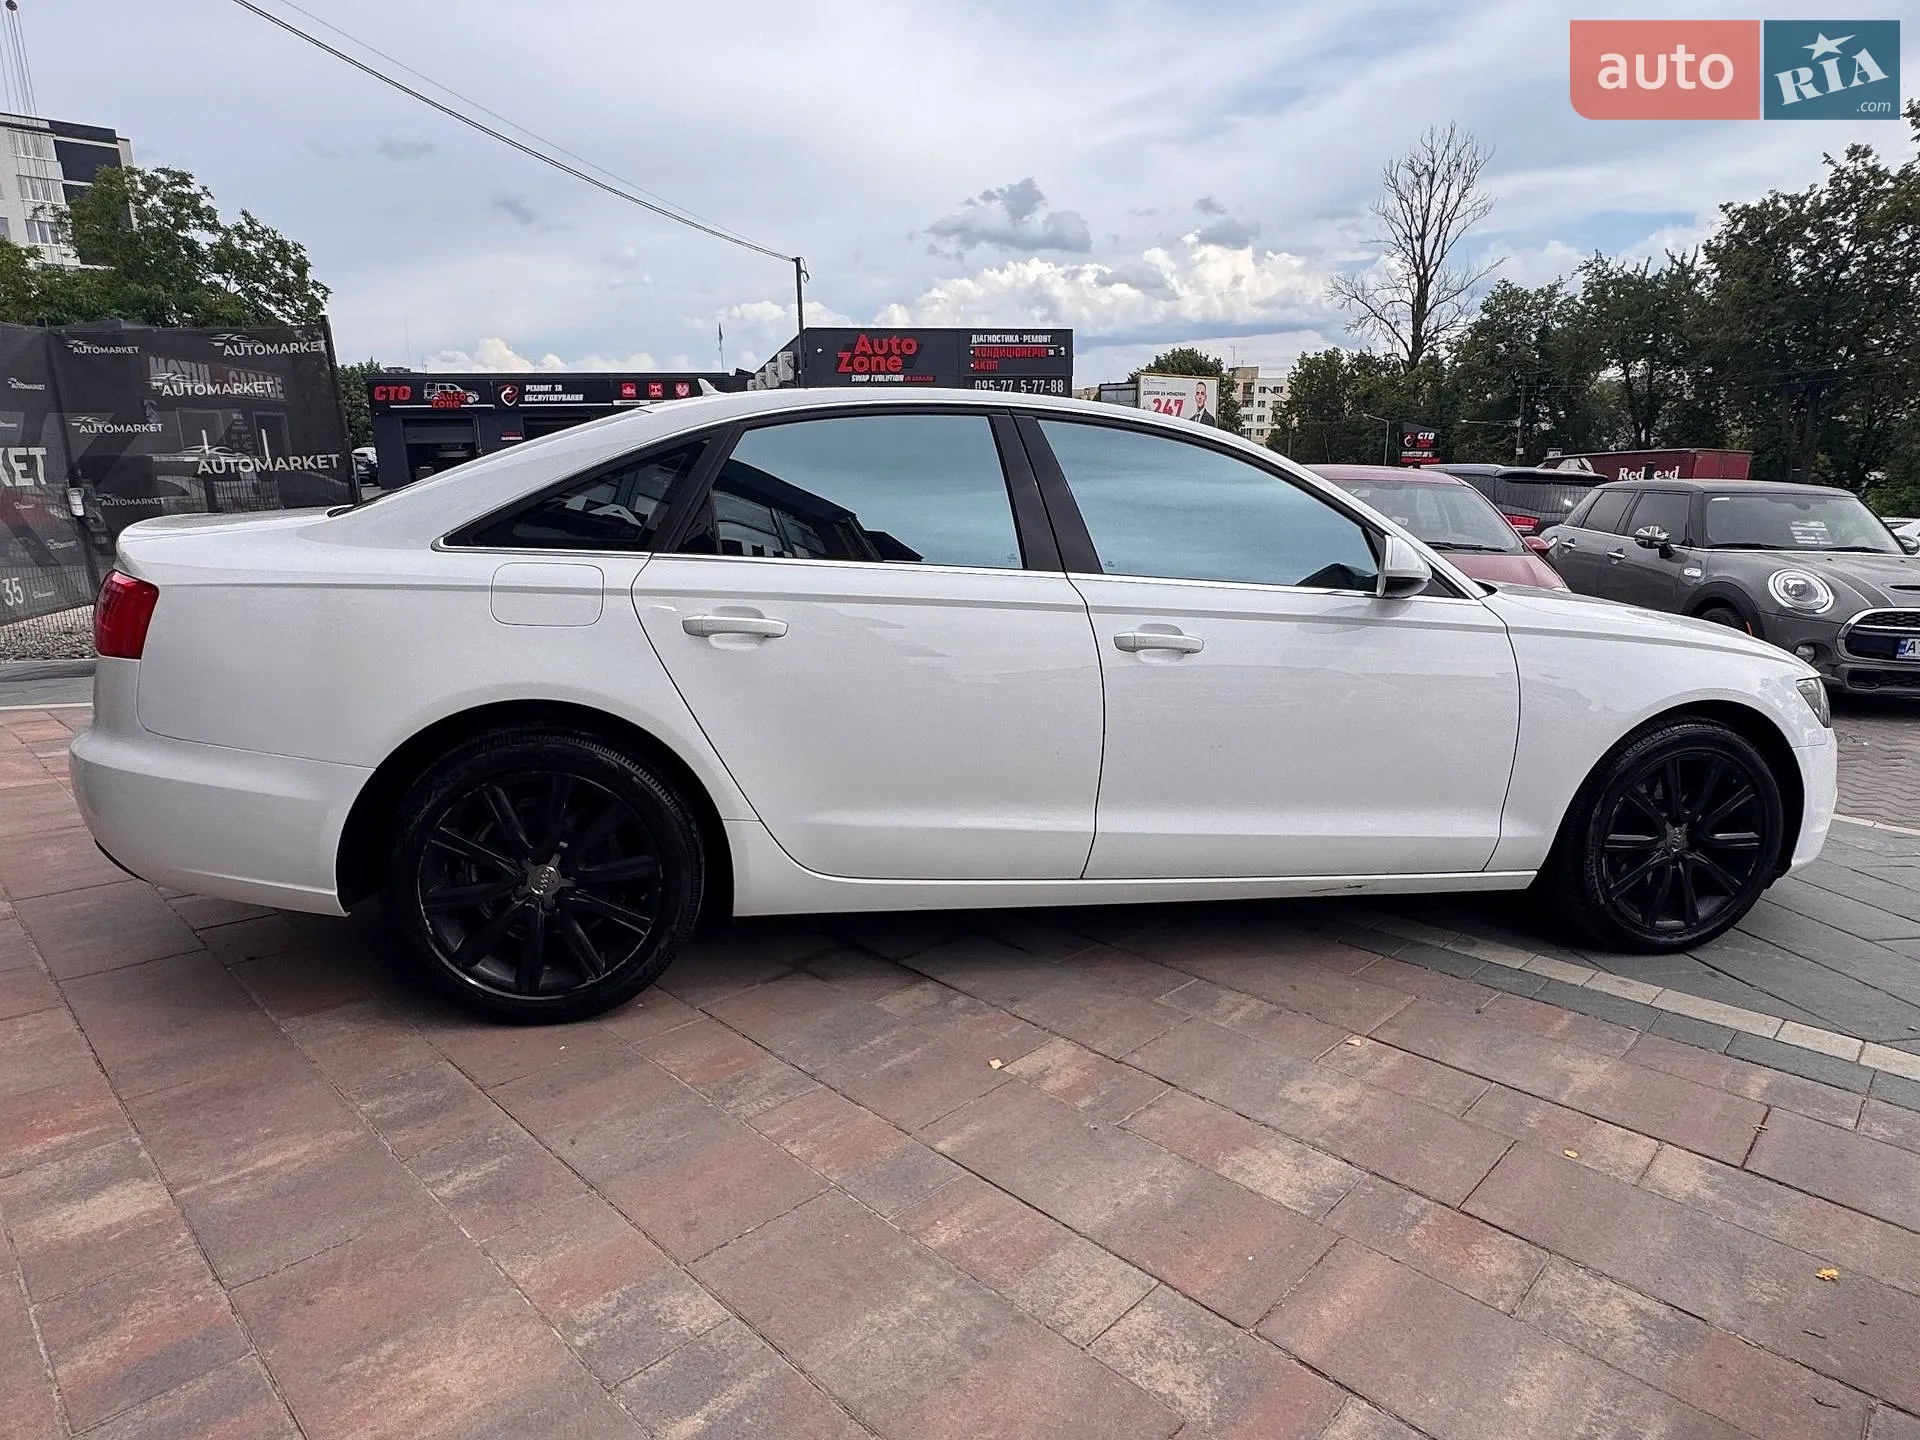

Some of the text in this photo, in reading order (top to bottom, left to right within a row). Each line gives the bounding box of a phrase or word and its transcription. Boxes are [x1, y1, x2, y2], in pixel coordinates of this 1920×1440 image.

[854, 334, 917, 355] Auto
[971, 334, 1052, 344] ДІАГНОСТИКА РЕМОНТ
[72, 346, 140, 354] AUTOMARKET
[223, 340, 327, 357] AUTOMARKET
[974, 347, 1047, 358] КОНДИЦІОНЕРІВ
[837, 352, 903, 373] Zone
[974, 360, 998, 371] АКПП
[161, 380, 275, 397] AUTOMARKET
[1020, 380, 1064, 393] 5-77-88
[374, 386, 412, 401] СТО
[79, 423, 164, 434] AUTOMARKET
[197, 453, 340, 476] AUTOMARKET
[102, 498, 165, 507] AUTOMARKET
